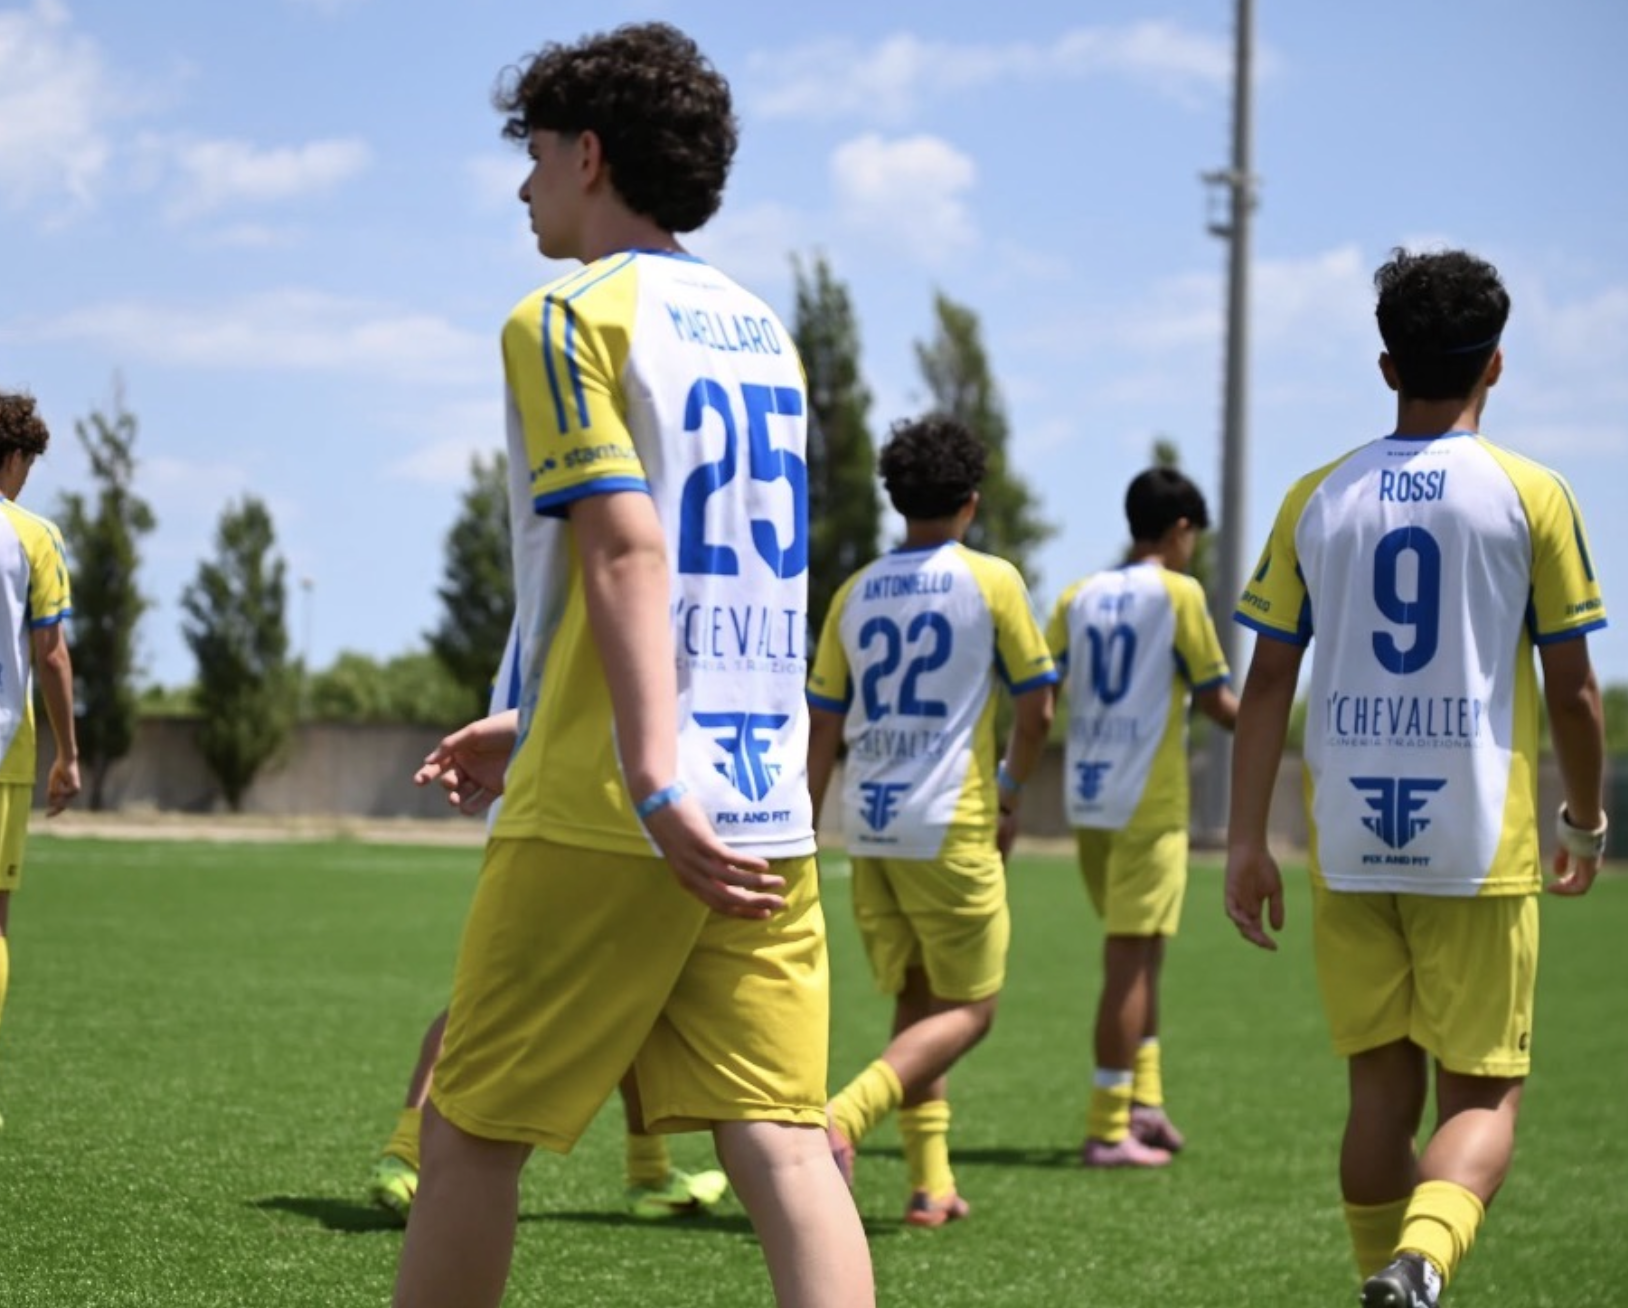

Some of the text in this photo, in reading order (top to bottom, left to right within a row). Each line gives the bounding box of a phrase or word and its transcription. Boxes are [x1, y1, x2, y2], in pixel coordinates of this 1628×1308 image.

[678, 377, 808, 579] 25
[1380, 469, 1446, 502] ROSSI
[1372, 525, 1440, 675] 9
[859, 611, 952, 722] 22
[716, 810, 791, 824] FIX AND FIT
